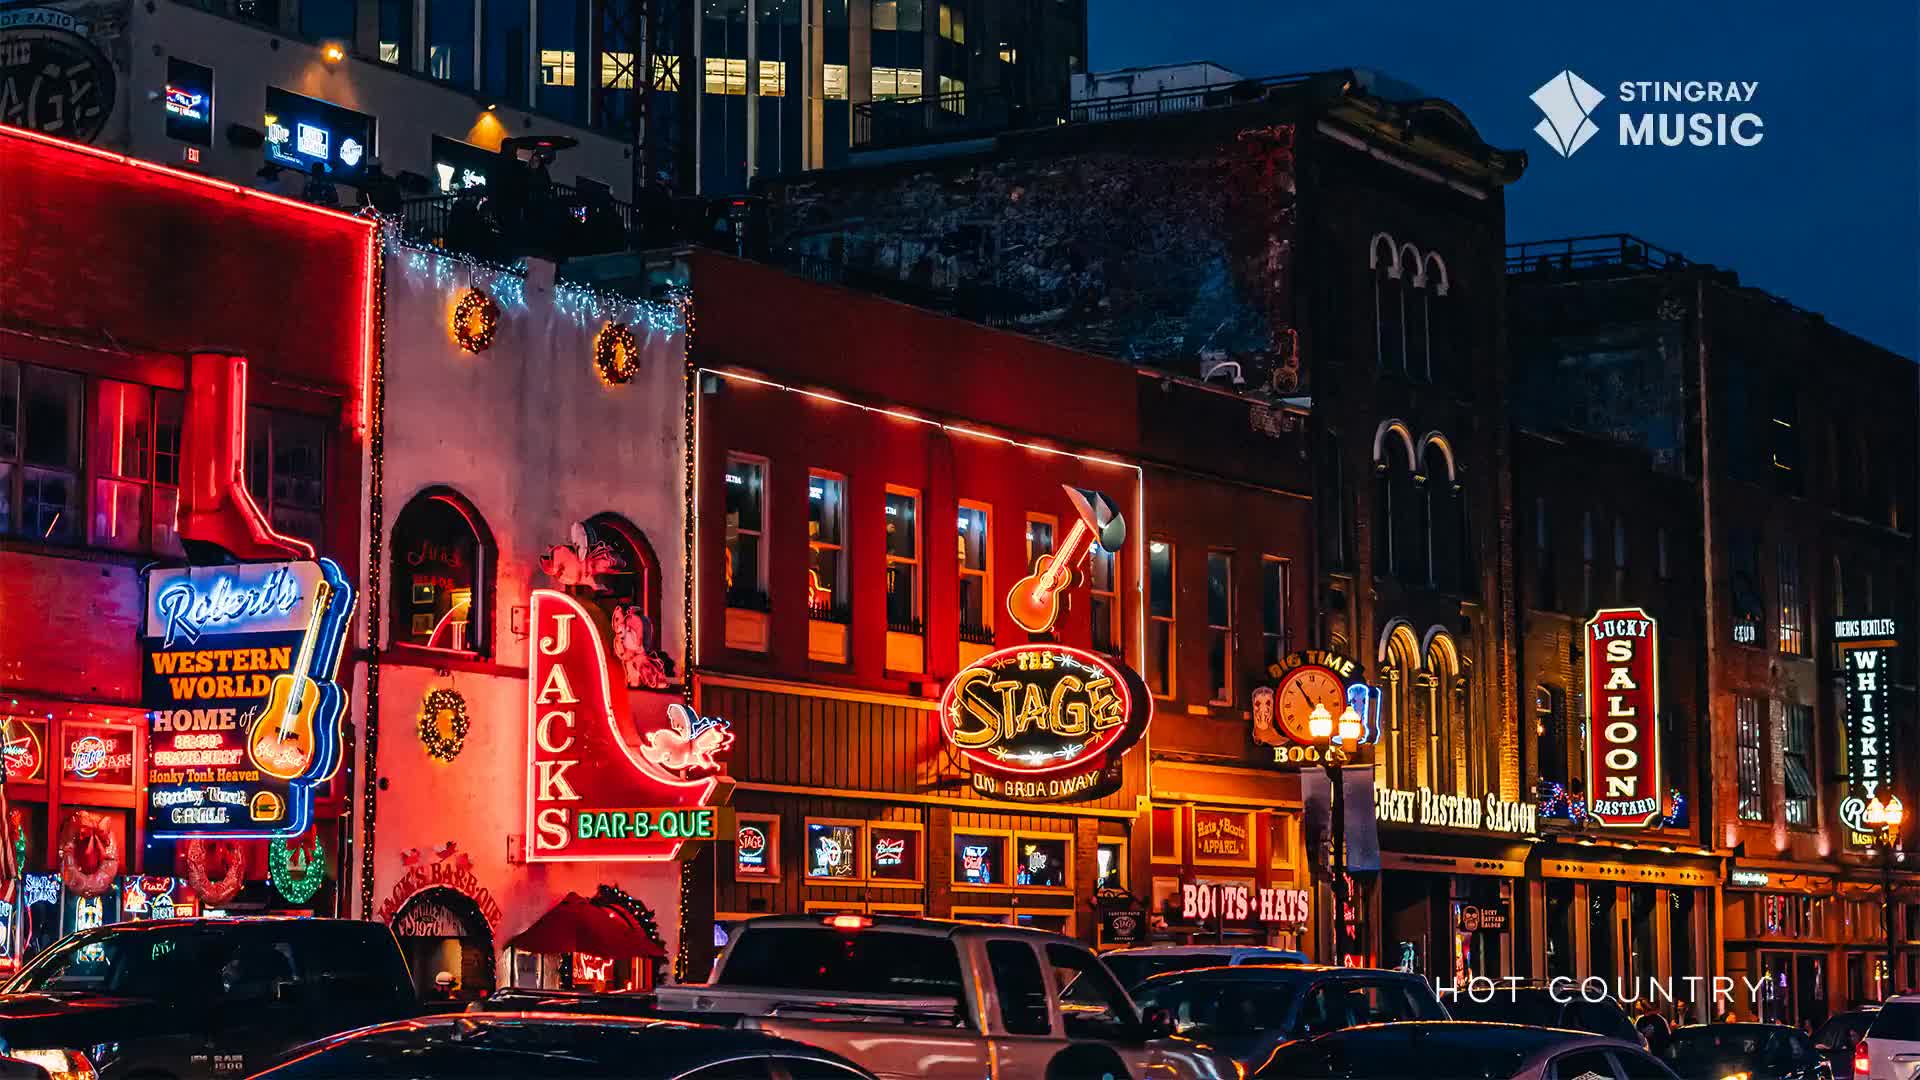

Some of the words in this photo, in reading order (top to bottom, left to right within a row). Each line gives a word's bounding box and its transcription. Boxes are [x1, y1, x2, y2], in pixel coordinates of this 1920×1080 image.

[188, 148, 200, 163] EXIT
[1592, 618, 1650, 641] LUCKY
[151, 647, 292, 675] WESTERN
[1016, 650, 1054, 671] THE
[1267, 653, 1302, 679] BIG
[1305, 649, 1356, 678] TIME
[169, 675, 273, 700] WORLD
[152, 708, 237, 732] HOME
[239, 704, 258, 736] of
[953, 666, 1123, 749] STAGE
[1604, 639, 1639, 798] SALOON
[534, 613, 582, 851] JACKS
[1853, 650, 1879, 800] WHISKEY
[150, 768, 185, 786] Honky
[186, 768, 215, 783] Tonk
[217, 767, 260, 783] Heaven
[973, 773, 995, 793] ON
[1004, 770, 1100, 798] BROADWAY
[171, 806, 230, 824] GRILL
[1418, 785, 1481, 830] BASTARD
[1486, 793, 1537, 834] SALOON
[1593, 797, 1657, 817] BASTARD
[577, 810, 713, 839] BAR-B-QUE
[738, 831, 763, 849] STAGE
[1203, 839, 1241, 855] APPAREL
[1259, 887, 1309, 922] HATS
